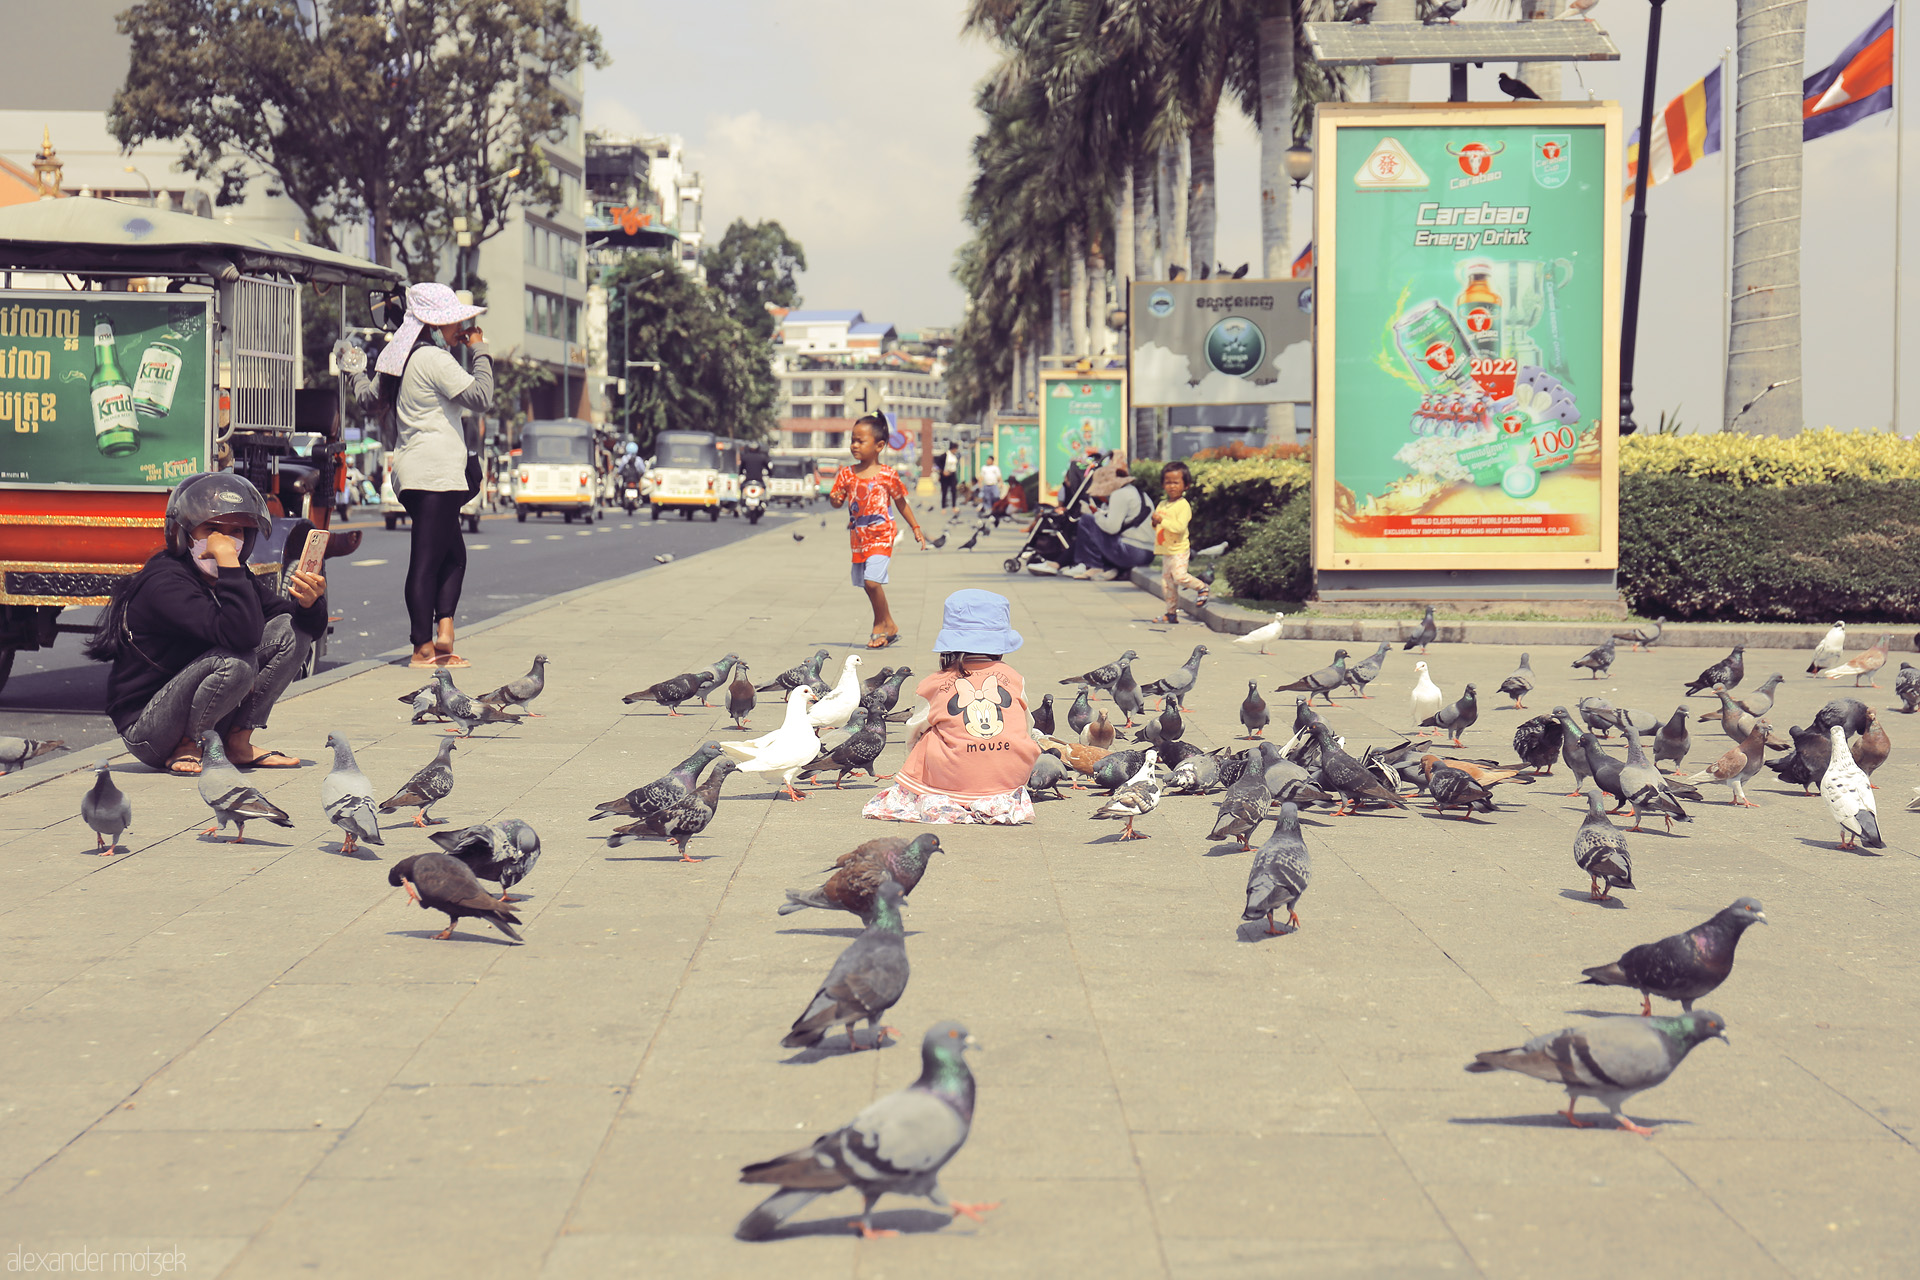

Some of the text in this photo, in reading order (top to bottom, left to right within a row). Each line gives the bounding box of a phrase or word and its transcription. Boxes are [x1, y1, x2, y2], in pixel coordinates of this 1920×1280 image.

[1450, 170, 1502, 190] Carabao
[1416, 201, 1531, 226] Carabao
[1414, 228, 1532, 251] Energy Drink
[140, 362, 175, 382] Krud
[1470, 357, 1517, 376] 2022
[98, 394, 133, 421] Krud
[1530, 425, 1576, 459] 100
[140, 463, 156, 472] GOOD
[149, 468, 162, 477] TIME
[163, 457, 198, 480] Krud
[146, 474, 157, 482] FOR
[1411, 516, 1542, 526] WORLD CLASS PRODUCT WORLD CLASS BRAND
[1384, 528, 1421, 536] EXCLUSIVELY
[966, 741, 1010, 753] mouse
